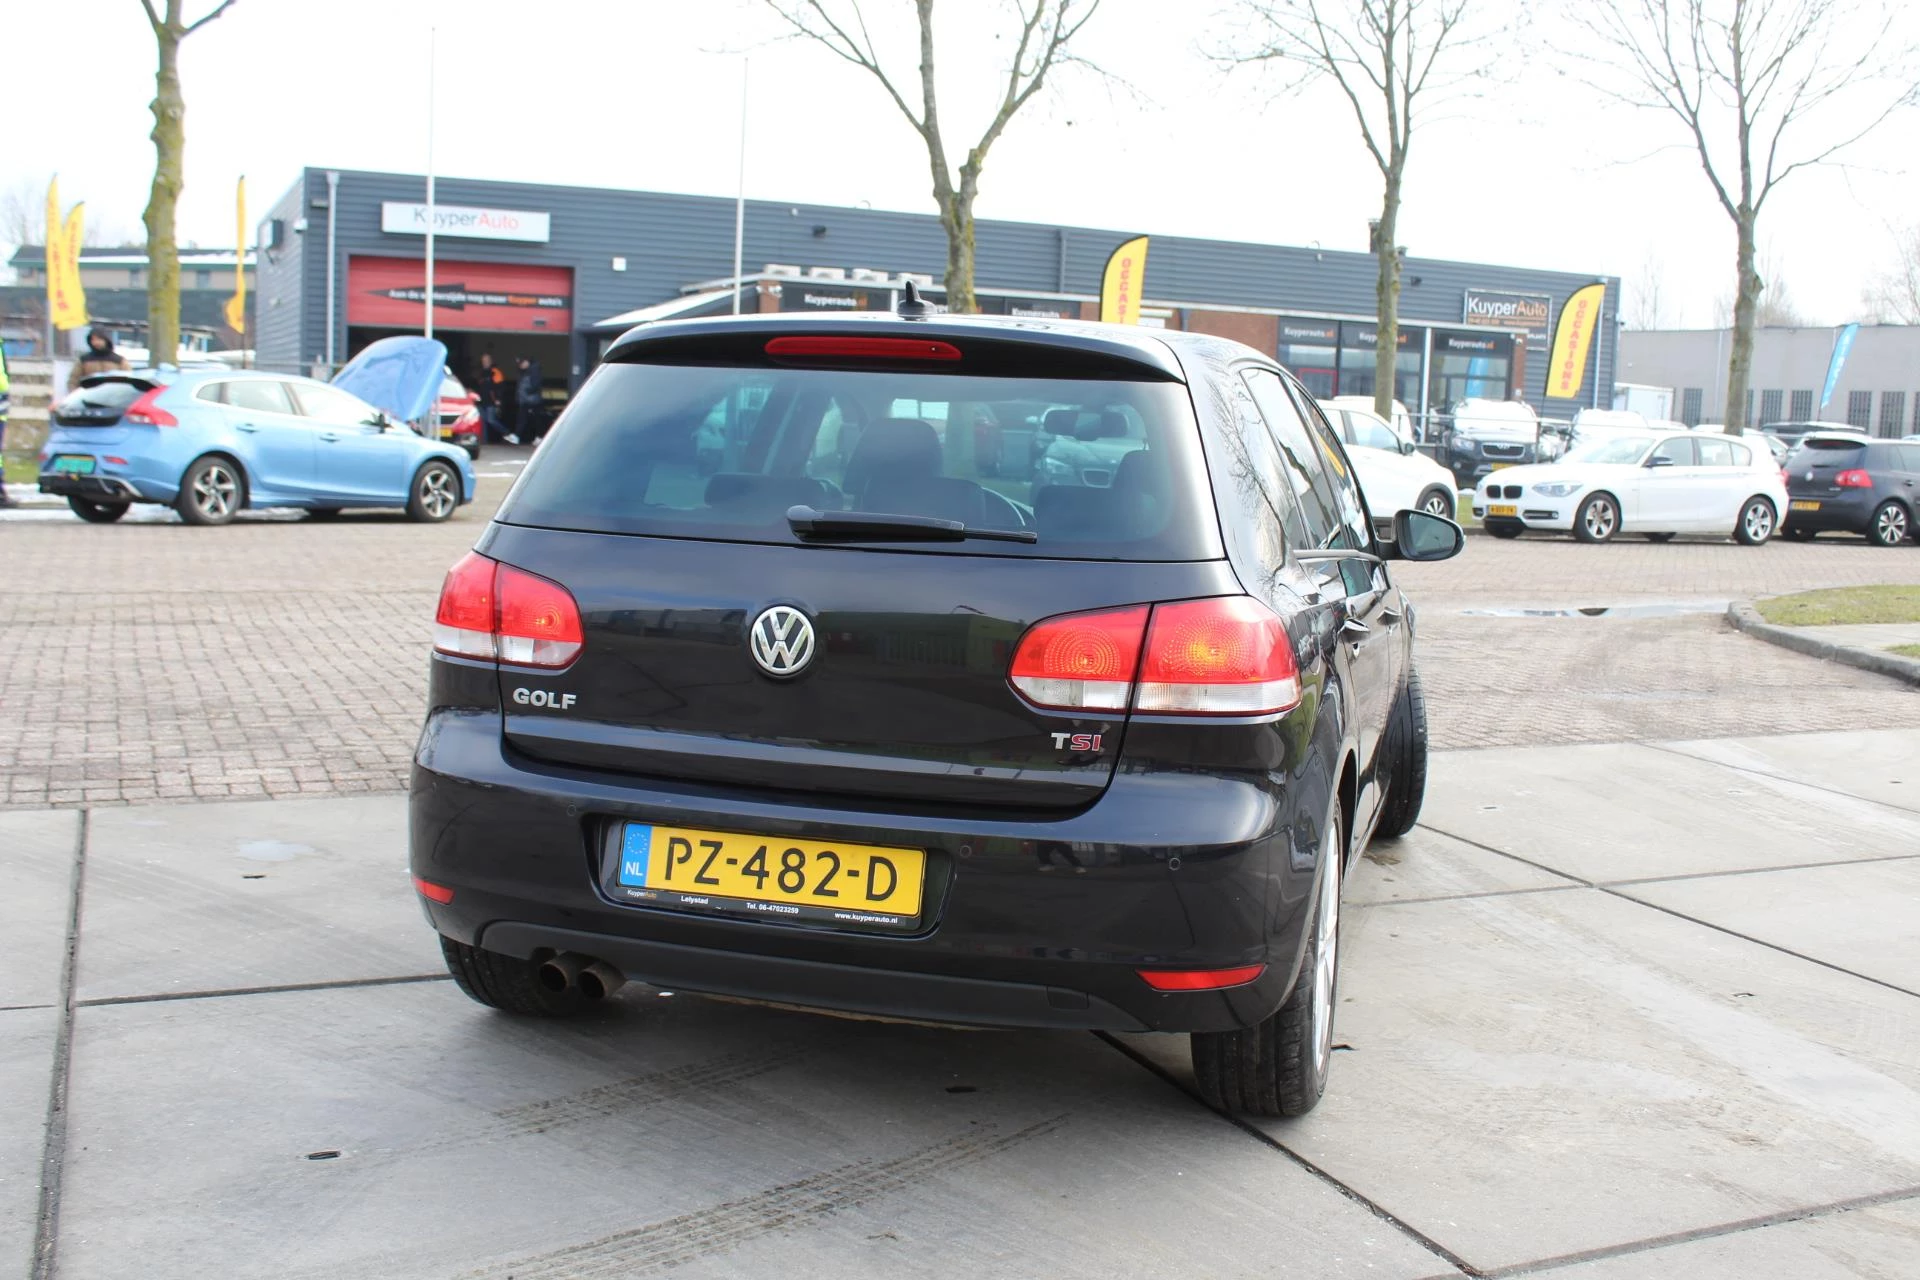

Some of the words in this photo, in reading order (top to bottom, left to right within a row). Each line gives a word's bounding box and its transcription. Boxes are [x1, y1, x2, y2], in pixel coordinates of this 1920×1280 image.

[414, 207, 519, 230] KyperAuto
[1119, 257, 1132, 324] OCCASI
[1468, 297, 1547, 318] KuyperAuto
[1284, 327, 1335, 339] Kuyperauto.nl
[1561, 299, 1588, 391] OCCASIONS
[751, 606, 815, 675] VW
[512, 687, 577, 710] GOLF
[1050, 732, 1102, 752] TSI
[625, 861, 643, 877] NL
[664, 836, 898, 902] PZ-482-D
[627, 889, 657, 900] KuyperAuto
[681, 895, 709, 905] Lelystad
[746, 902, 758, 910] Tel.
[834, 911, 898, 924] www.kuyperauto.nl
